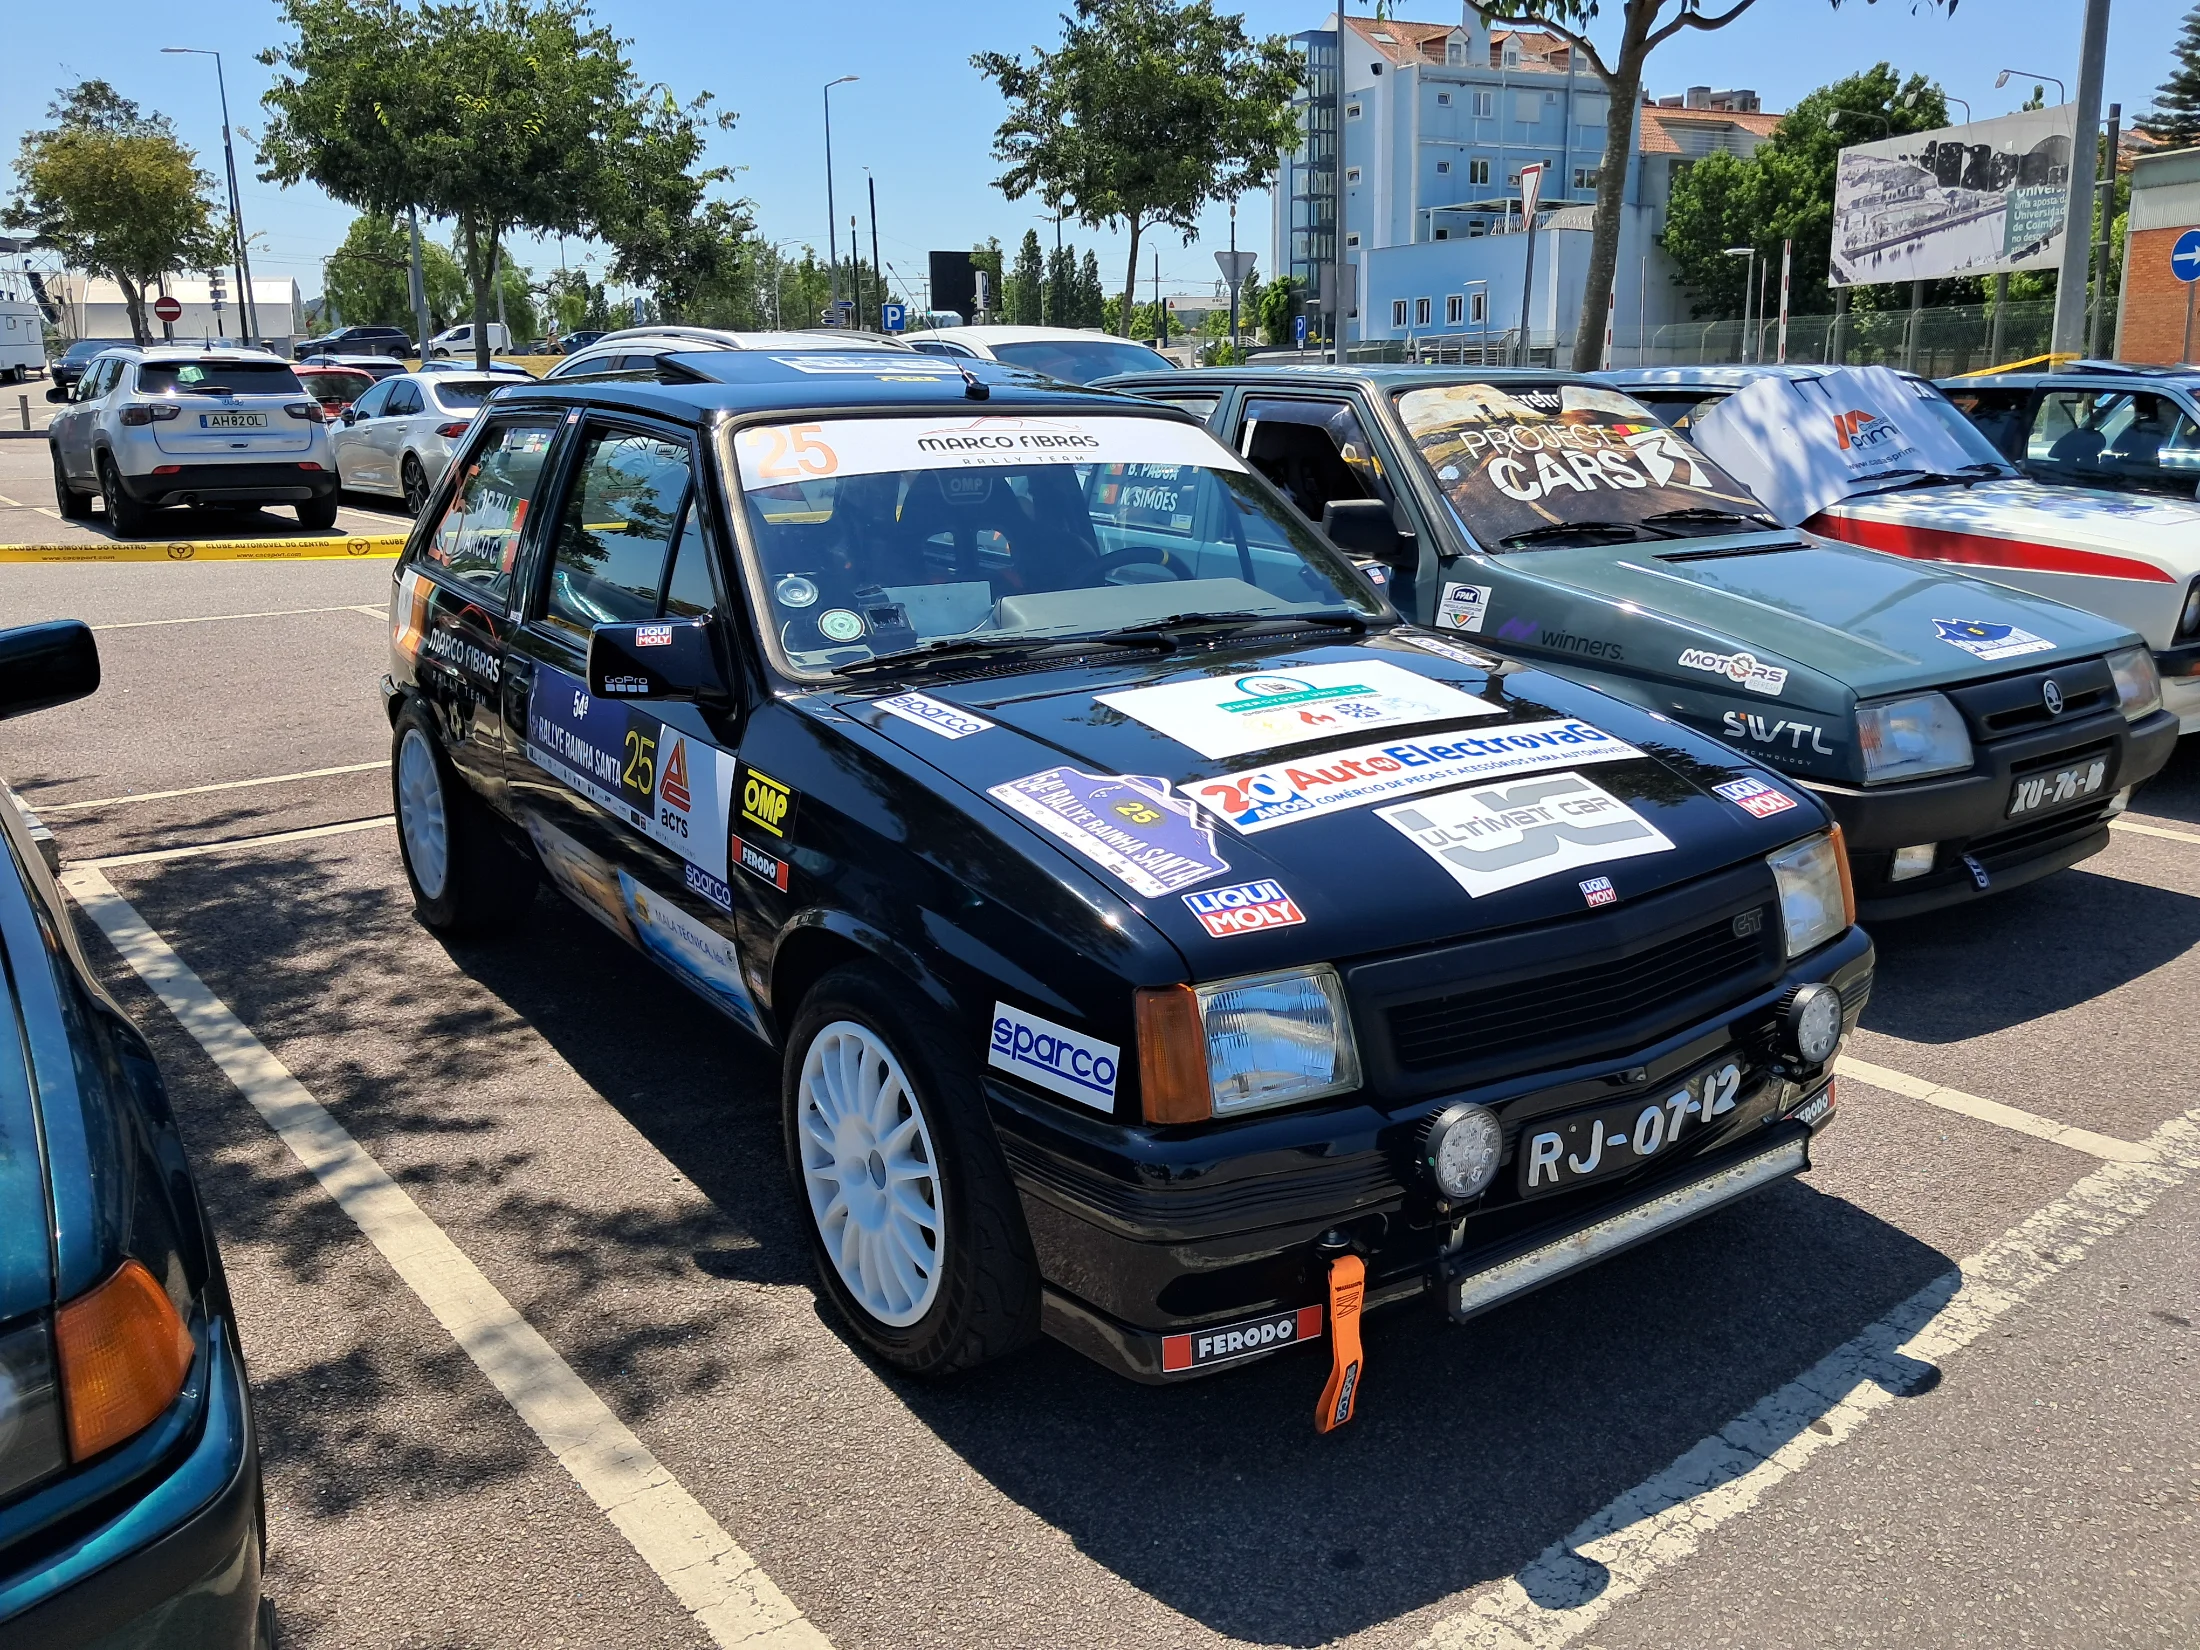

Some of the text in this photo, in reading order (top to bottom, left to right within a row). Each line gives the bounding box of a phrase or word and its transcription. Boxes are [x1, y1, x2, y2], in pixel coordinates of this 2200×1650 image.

[2014, 206, 2066, 220] Universidad
[2033, 198, 2058, 209] aposta
[2012, 222, 2023, 232] de
[887, 307, 900, 328] P
[746, 425, 838, 479] 25
[918, 434, 1100, 452] MARCO FIBRAS
[1459, 424, 1615, 460] PROJECT
[962, 455, 1086, 465] RALLY TEAM
[951, 477, 983, 492] OMP
[1488, 450, 1647, 501] CARS
[112, 543, 147, 551] CENTRO
[381, 538, 404, 546] CLUBE
[1454, 590, 1477, 602] FPAK
[637, 635, 671, 646] MOLY
[639, 626, 672, 636] LIQUI
[428, 628, 501, 683] MARCO FIBRAS
[1541, 630, 1625, 661] winners.
[605, 675, 648, 685] GoPro
[1748, 679, 1780, 692] REFRESH
[465, 686, 486, 707] TEAM
[889, 696, 982, 734] sparco
[538, 716, 622, 789] RALLYE RAINHA SANTA
[623, 730, 655, 795] 25
[1736, 747, 1813, 766] TECHNOLOGY
[1316, 783, 1383, 806] COMÉRCIO
[1385, 778, 1405, 790] DE
[1408, 769, 1444, 787] PEÇAS
[1456, 757, 1526, 776] ACESSÓRIOS
[1527, 751, 1560, 765] PARA
[1562, 743, 1631, 761] AUTOMÓVEIS
[744, 779, 787, 825] OMP
[1200, 774, 1311, 821] 20 ANOS
[1717, 778, 1771, 800] LIQUI
[1745, 790, 1789, 815] MOLY
[661, 807, 689, 839] acrs
[1115, 803, 1160, 824] 25
[1039, 788, 1096, 825] RALLYE
[1083, 817, 1147, 856] RAINHA
[1130, 846, 1213, 887] SANTA
[742, 846, 776, 879] FERODO
[685, 864, 732, 910] sparco
[1189, 881, 1282, 914] LIQUI
[1582, 878, 1612, 894] LIQUI
[1588, 888, 1615, 904] MOLY
[1208, 902, 1292, 935] MOLY
[992, 1017, 1116, 1092] sparco
[1527, 1064, 1741, 1187] RJ-07-12
[1198, 1320, 1293, 1358] FERODO
[1336, 1364, 1357, 1422] sparco
